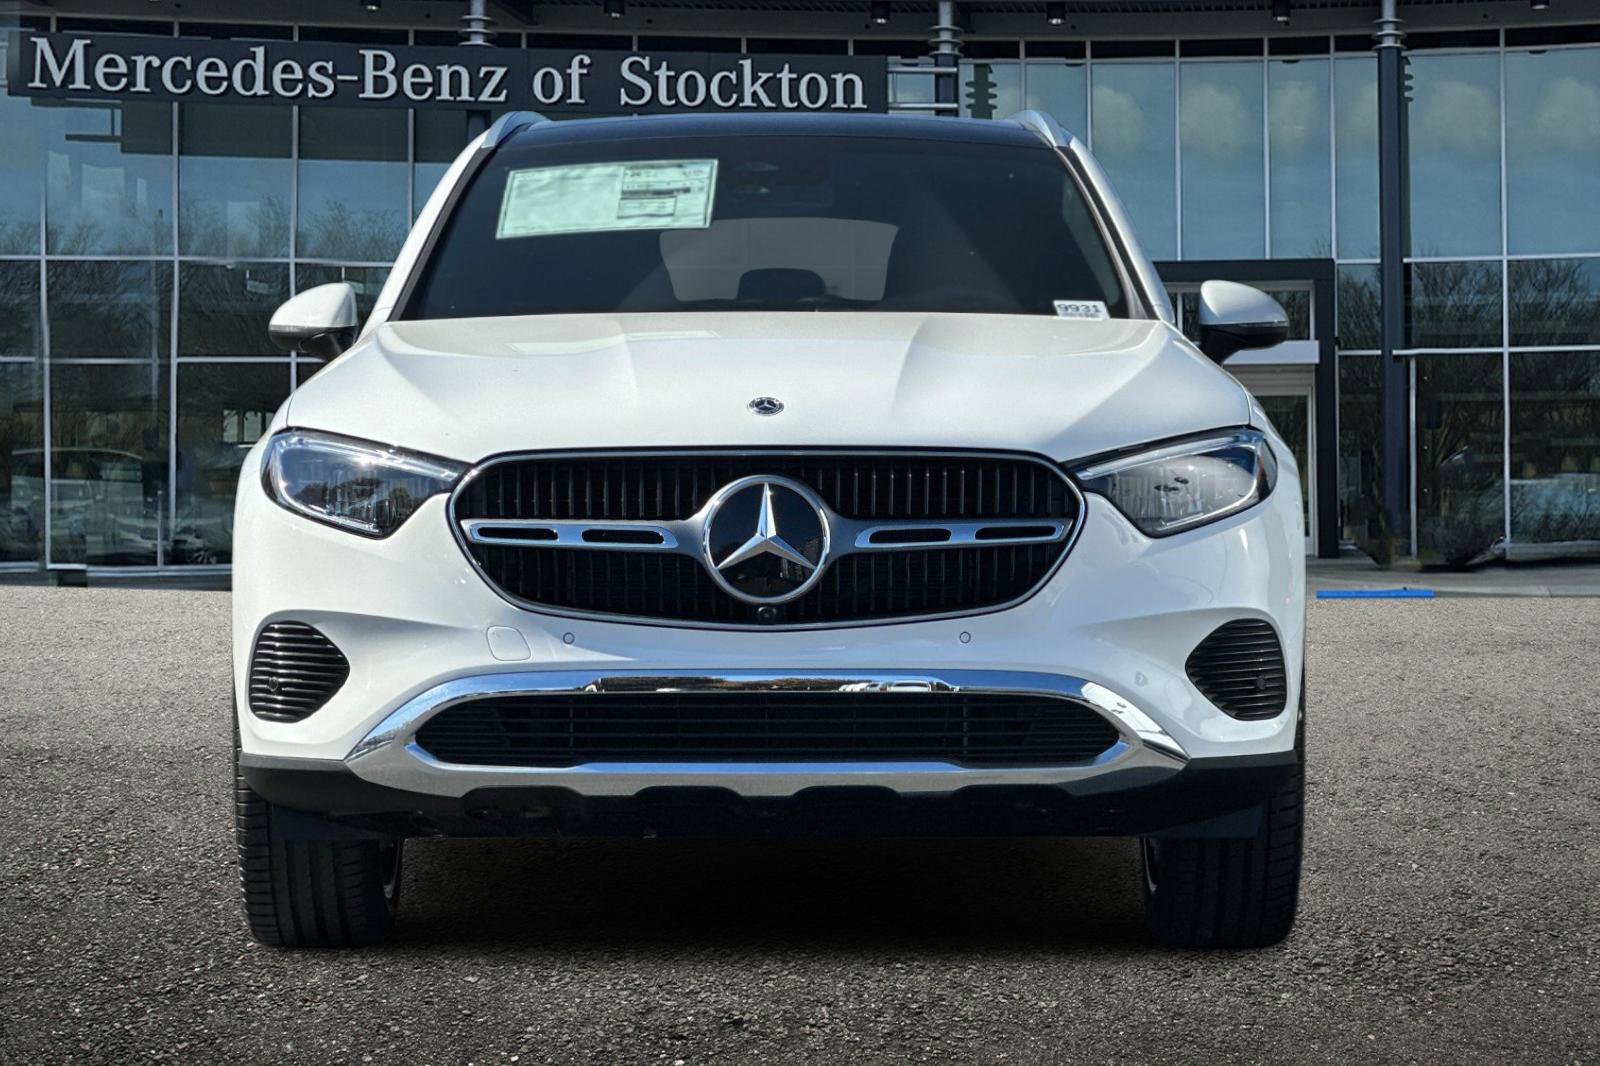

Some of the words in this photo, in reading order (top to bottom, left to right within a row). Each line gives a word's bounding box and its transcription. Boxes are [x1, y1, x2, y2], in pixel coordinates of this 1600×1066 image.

[28, 36, 508, 102] Mercedes-Benz
[532, 54, 591, 104] of
[619, 55, 868, 109] Stockton
